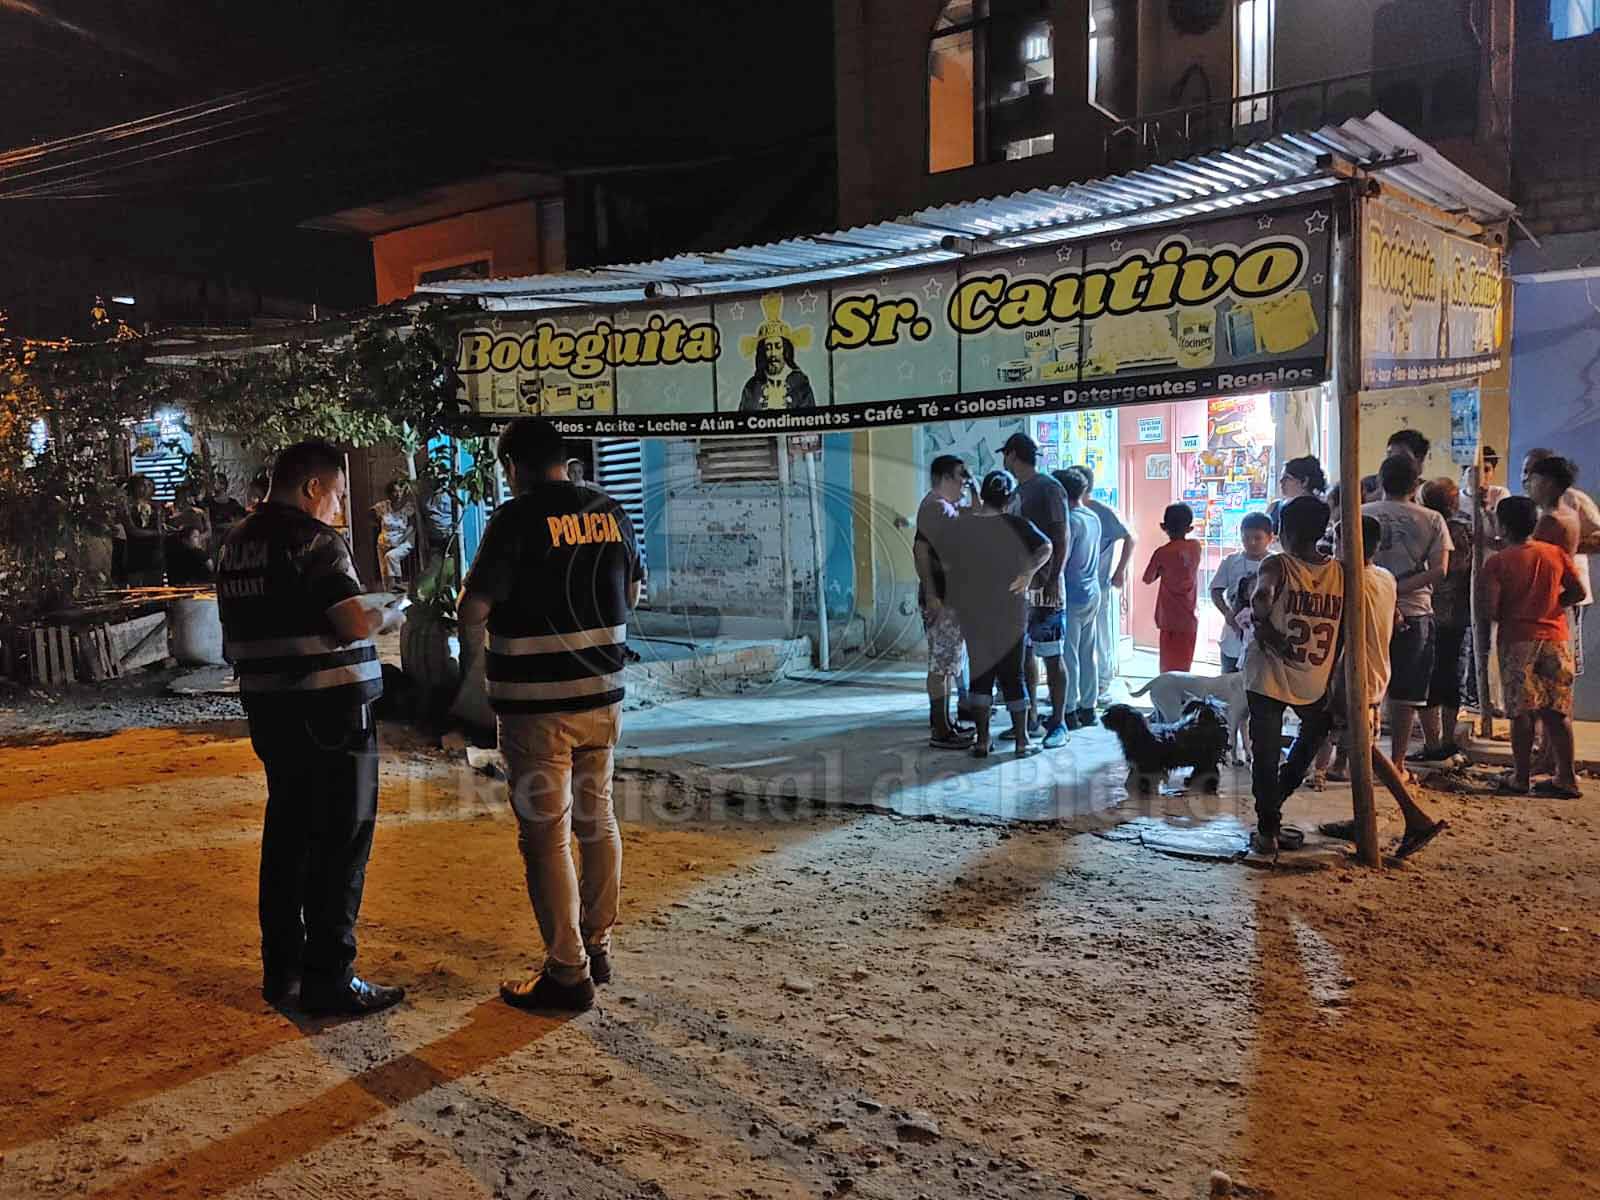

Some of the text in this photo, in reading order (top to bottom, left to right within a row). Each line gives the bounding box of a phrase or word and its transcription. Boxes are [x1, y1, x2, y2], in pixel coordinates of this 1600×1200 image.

[1367, 220, 1436, 311] Bodeguita
[458, 240, 1305, 378] Bodeguita Sr. Cautivo
[552, 420, 584, 433] deos
[595, 421, 636, 433] Aceite
[647, 419, 688, 432] Leche
[699, 416, 736, 431] Atún
[746, 411, 850, 429] Condimentos
[864, 404, 903, 422] Café
[918, 401, 940, 417] Té
[954, 393, 1046, 413] Golosinas
[1063, 380, 1198, 405] Detergentes
[1218, 367, 1314, 390] Regalos
[546, 512, 623, 548] POLICIA
[1286, 618, 1335, 666] 23
